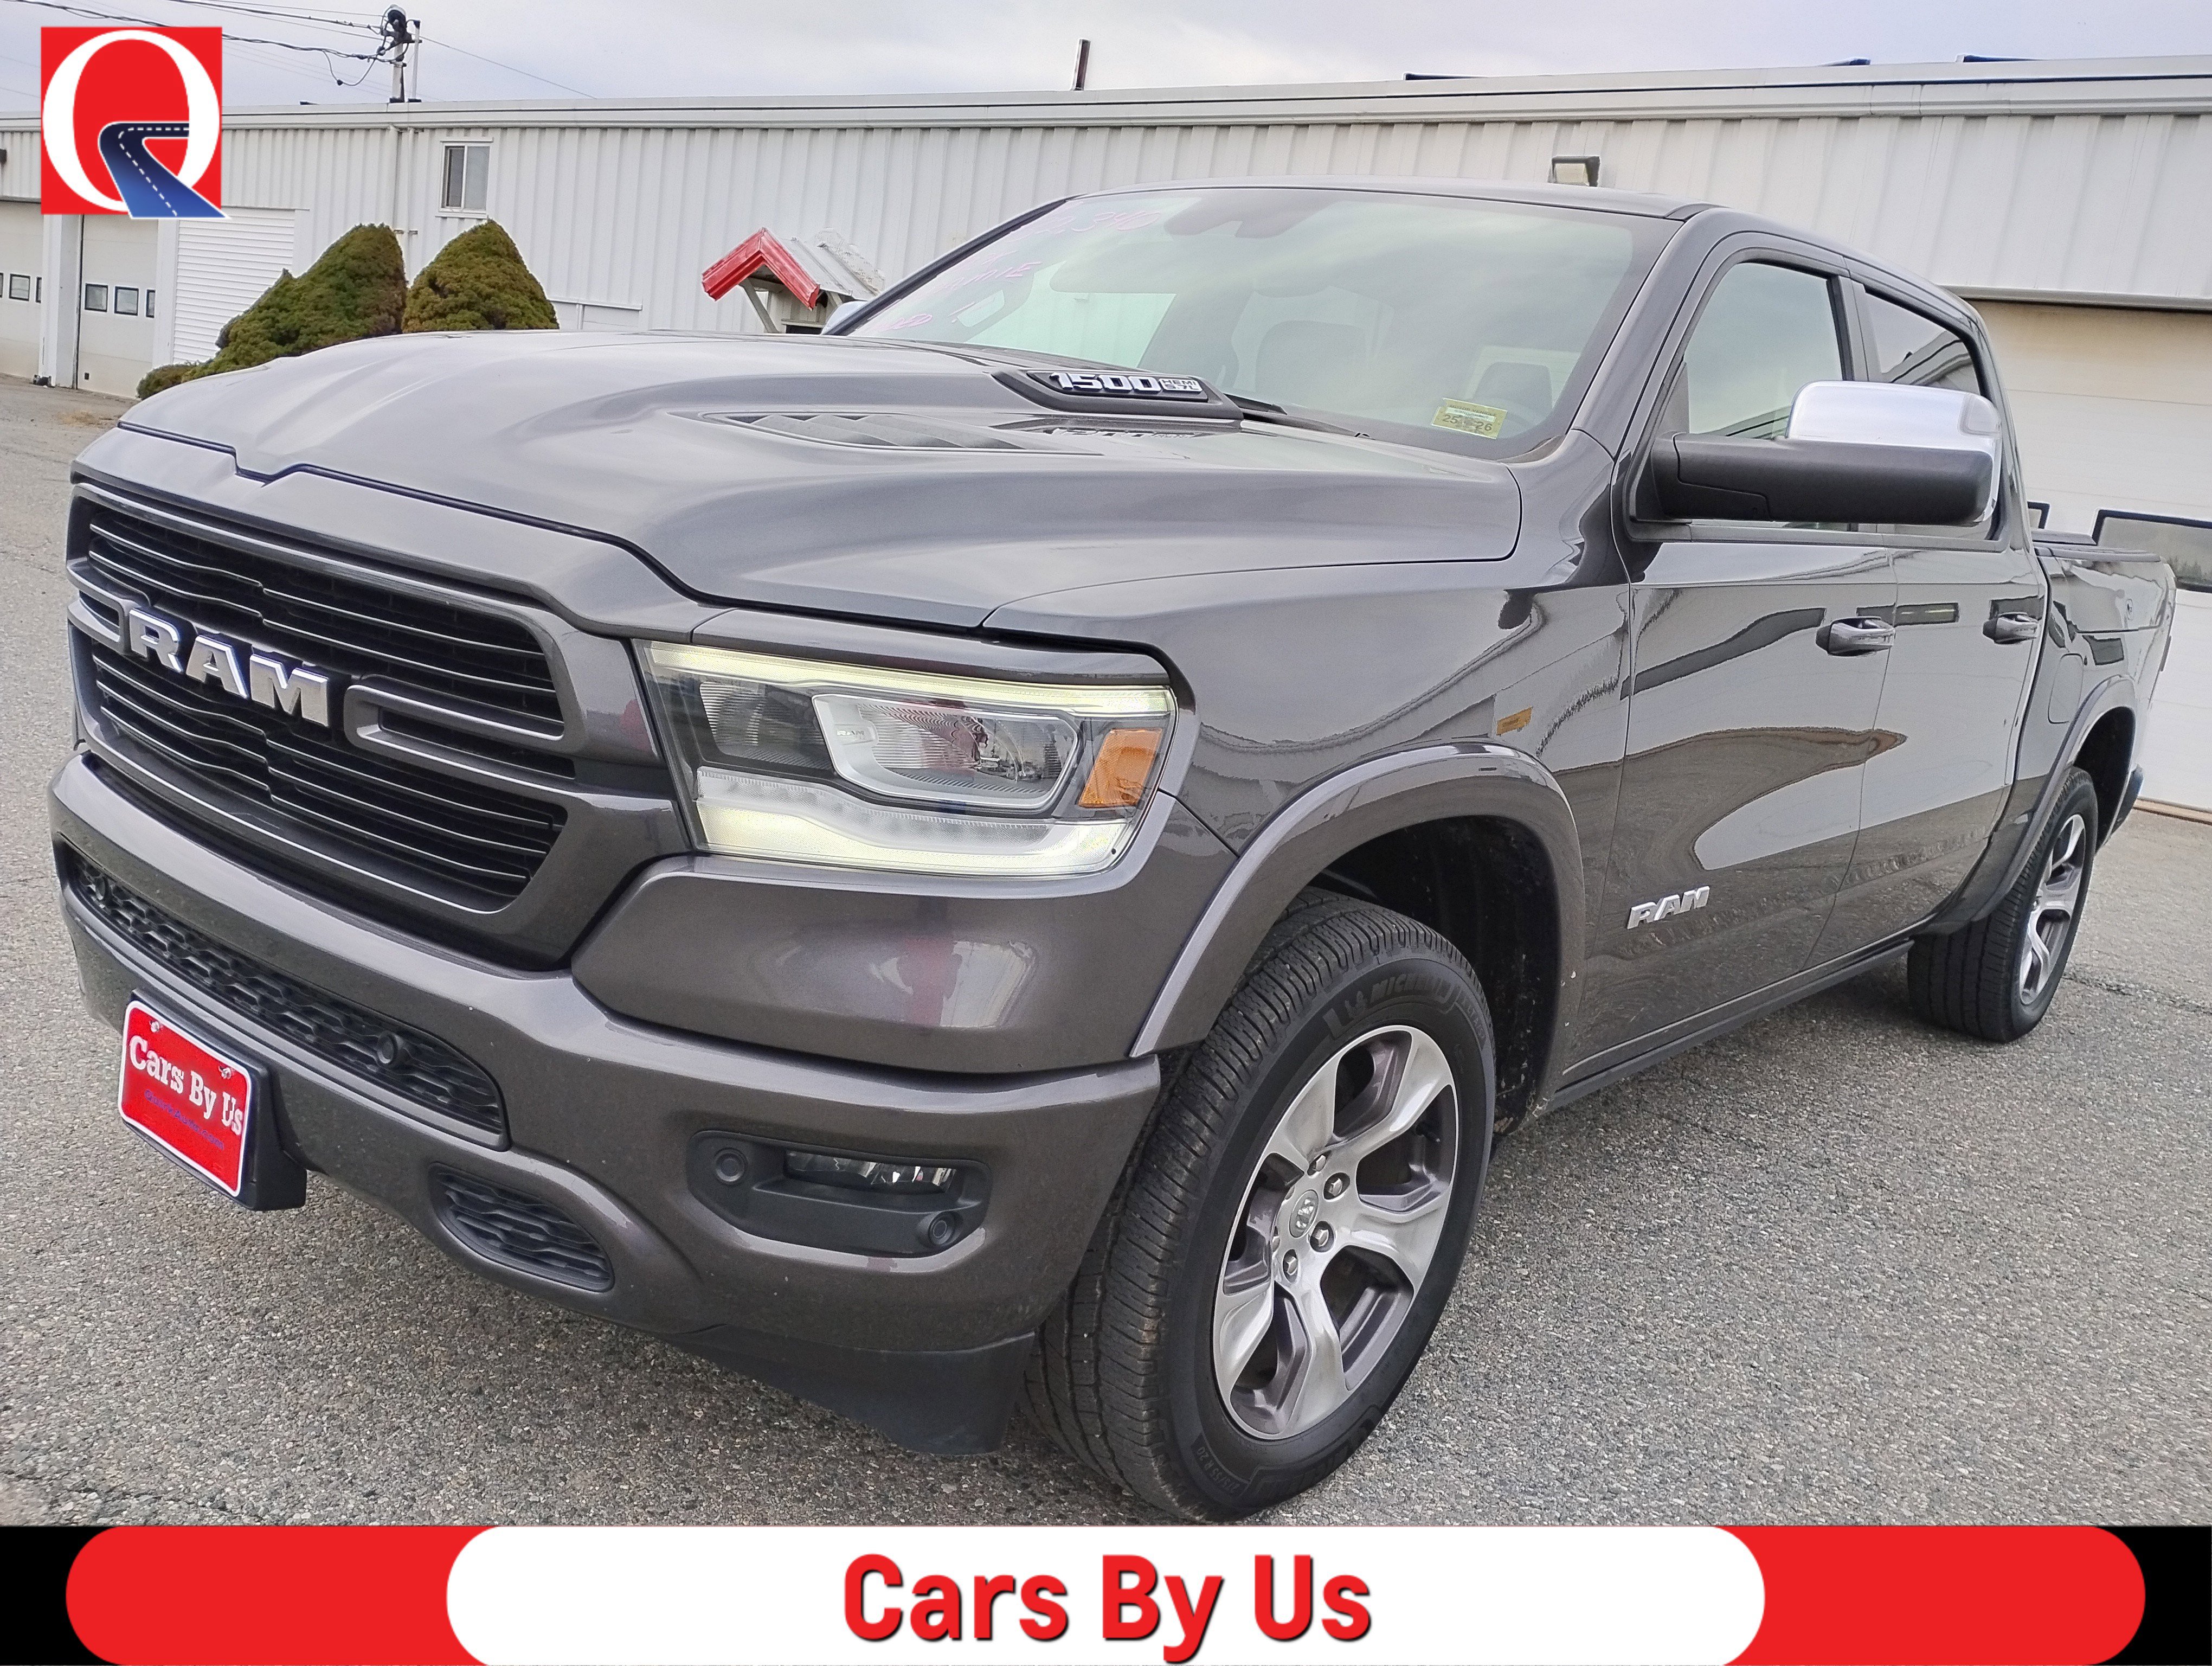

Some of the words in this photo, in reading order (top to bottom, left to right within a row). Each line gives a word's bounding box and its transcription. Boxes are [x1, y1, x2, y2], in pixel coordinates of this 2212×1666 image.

[1050, 372, 1161, 391] 1500
[1442, 414, 1460, 424] 25
[1475, 421, 1493, 431] 26
[128, 607, 329, 728] RAM
[1626, 885, 1711, 930] RAM
[129, 1035, 184, 1094] Cars
[189, 1070, 217, 1120] By
[221, 1091, 244, 1136] Us
